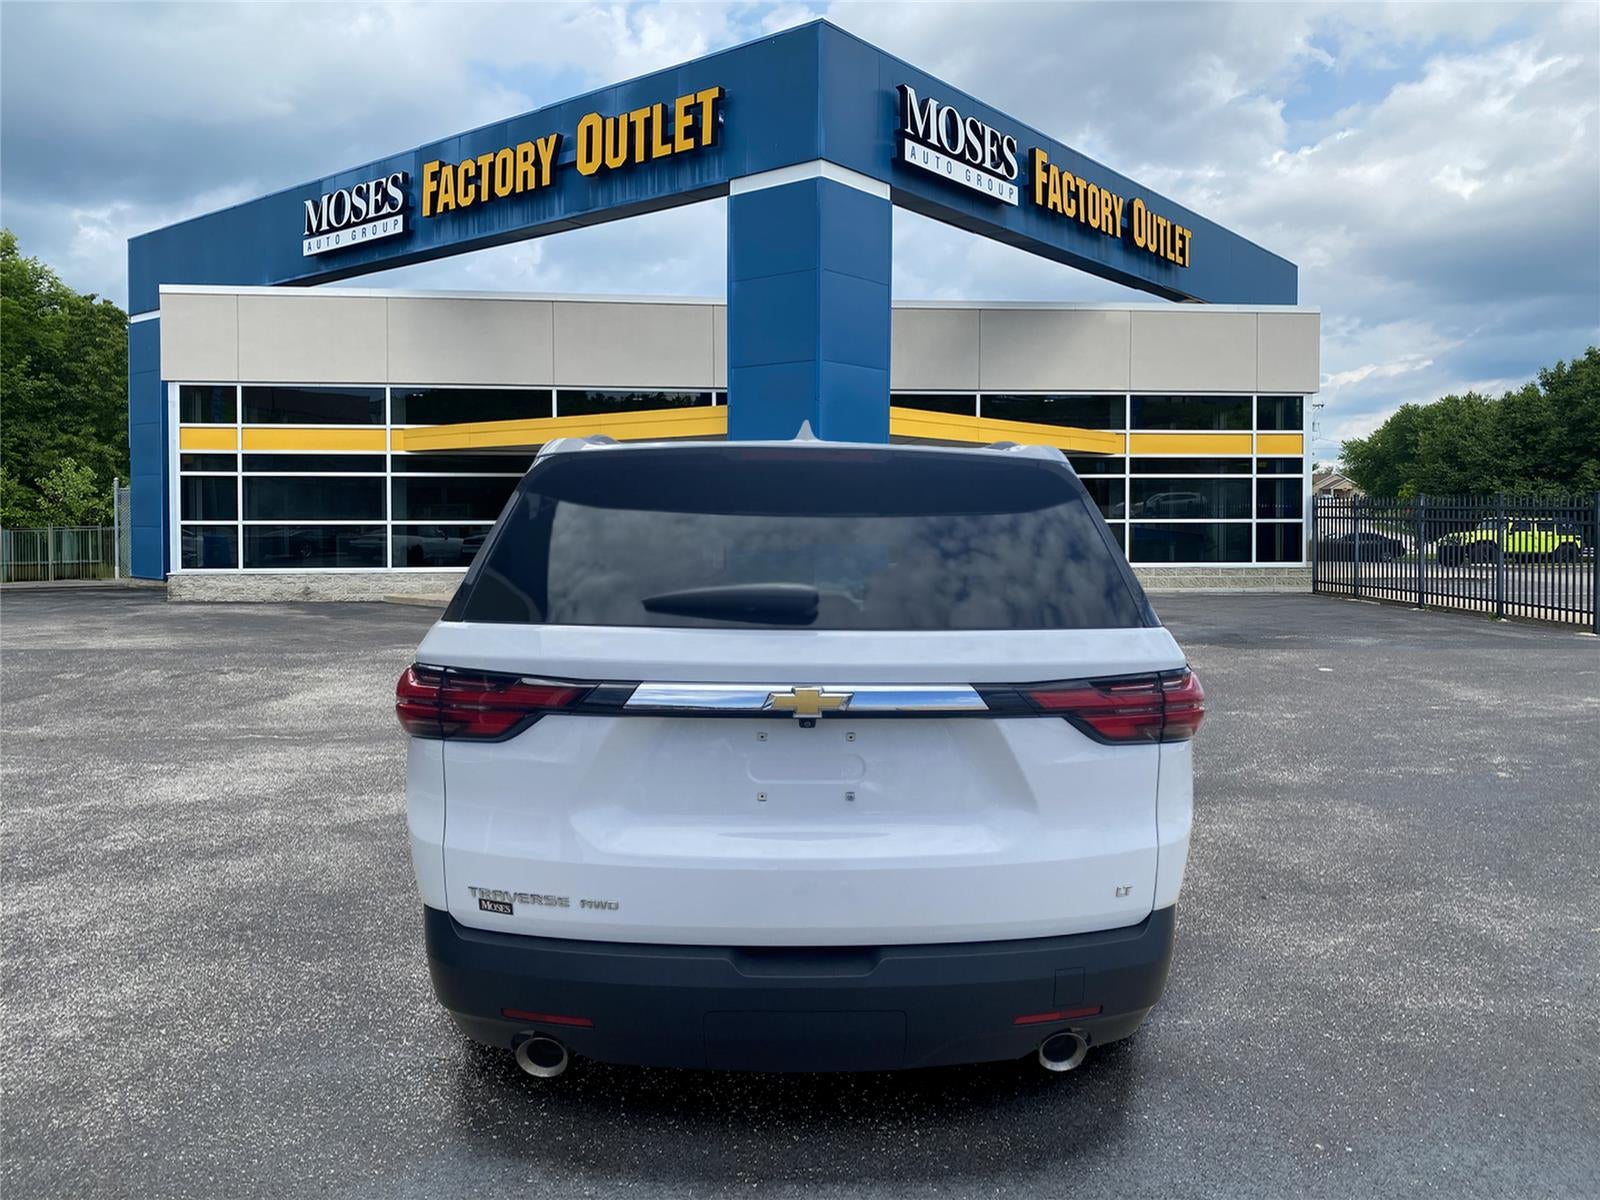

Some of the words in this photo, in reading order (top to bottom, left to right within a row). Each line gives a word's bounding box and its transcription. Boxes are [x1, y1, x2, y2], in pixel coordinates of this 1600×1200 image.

[422, 133, 559, 217] FACTORY
[576, 86, 720, 176] OUTLET
[904, 84, 1018, 180] MOSES
[910, 144, 953, 175] AUTO
[965, 168, 1015, 199] GROUP
[303, 171, 404, 236] MOSES
[1035, 147, 1124, 238] FACTORY
[1132, 197, 1192, 268] OUTLET
[306, 233, 341, 253] AUTO
[350, 217, 401, 242] GROUP
[468, 886, 570, 908] TRAVERSE
[580, 899, 619, 911] AWD
[480, 900, 512, 914] MOSES
